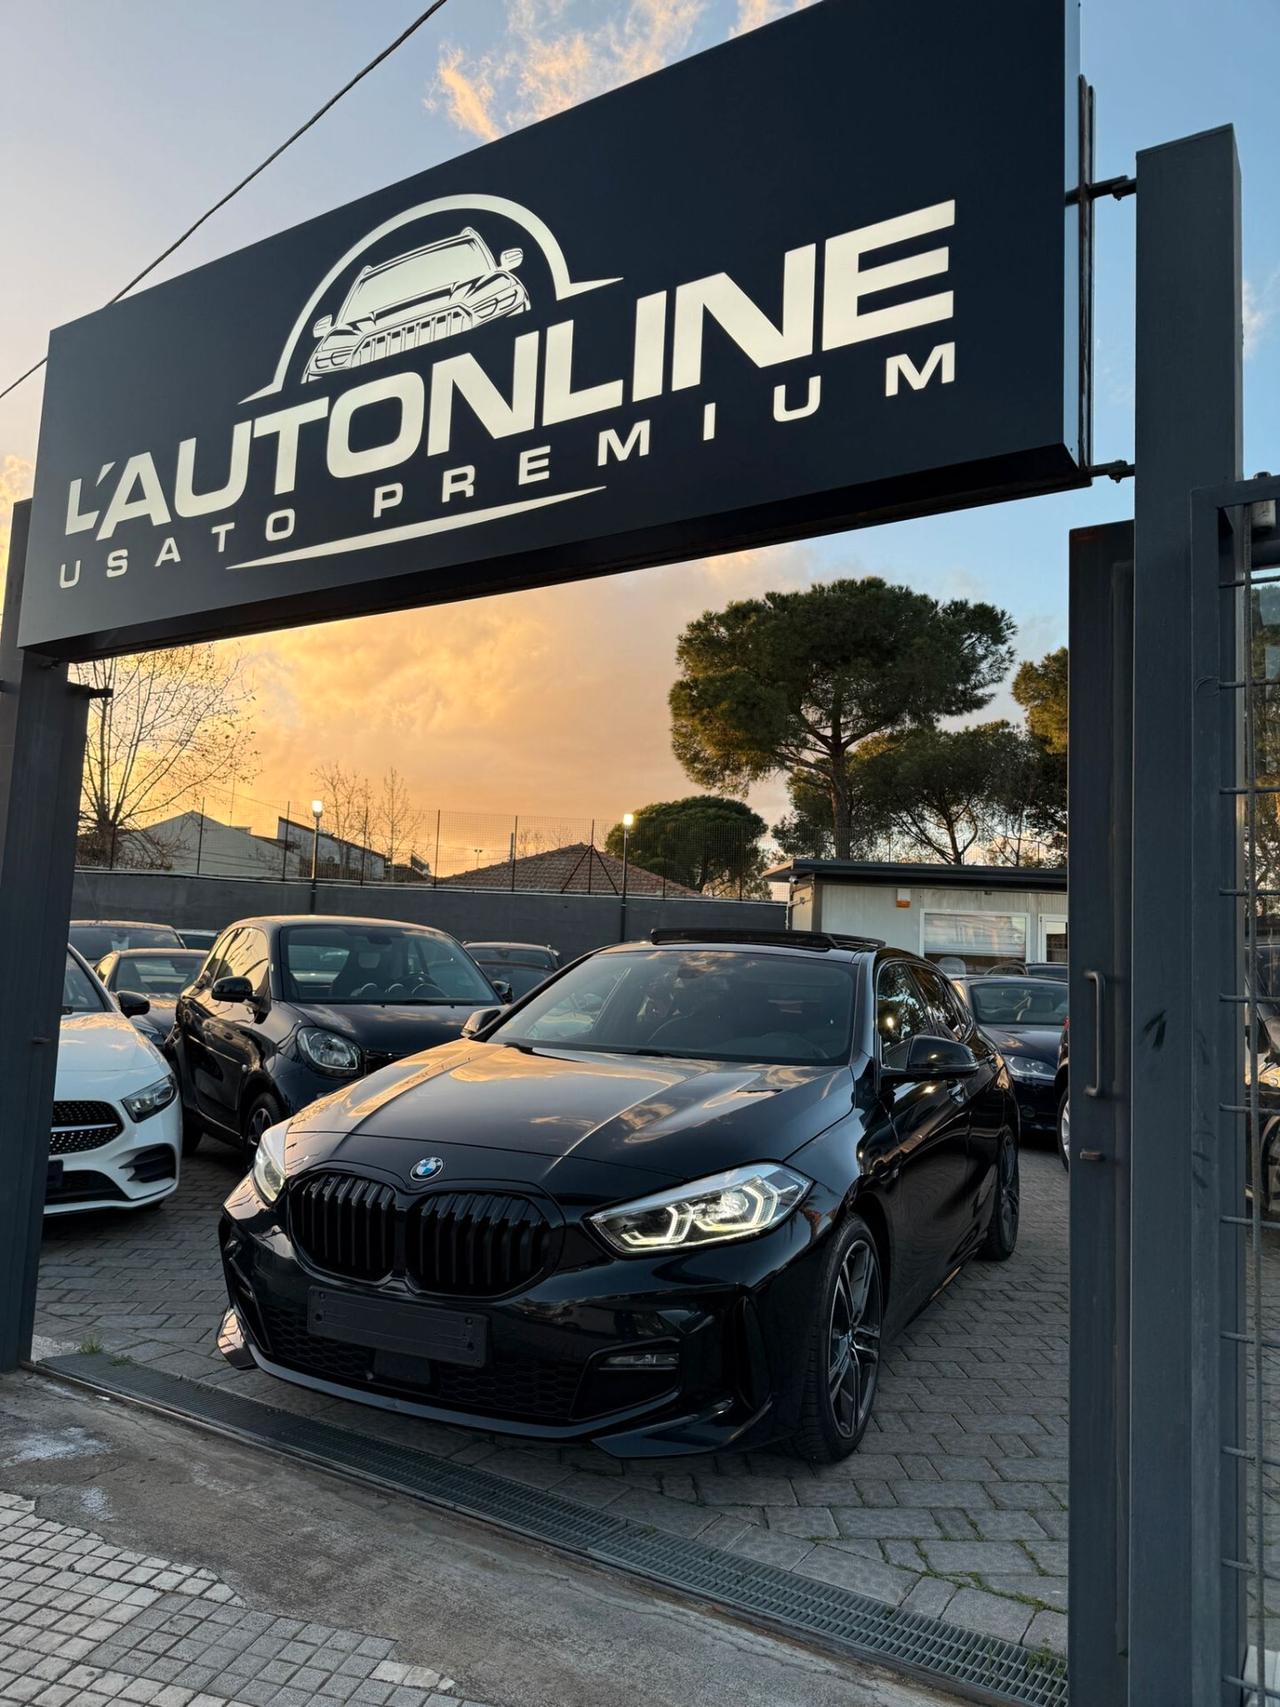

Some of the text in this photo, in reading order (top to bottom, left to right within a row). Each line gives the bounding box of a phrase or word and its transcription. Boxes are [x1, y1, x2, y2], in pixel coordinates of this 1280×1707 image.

[58, 341, 956, 589] USATO PREMIUM
[65, 199, 956, 542] L'AUTONLINE
